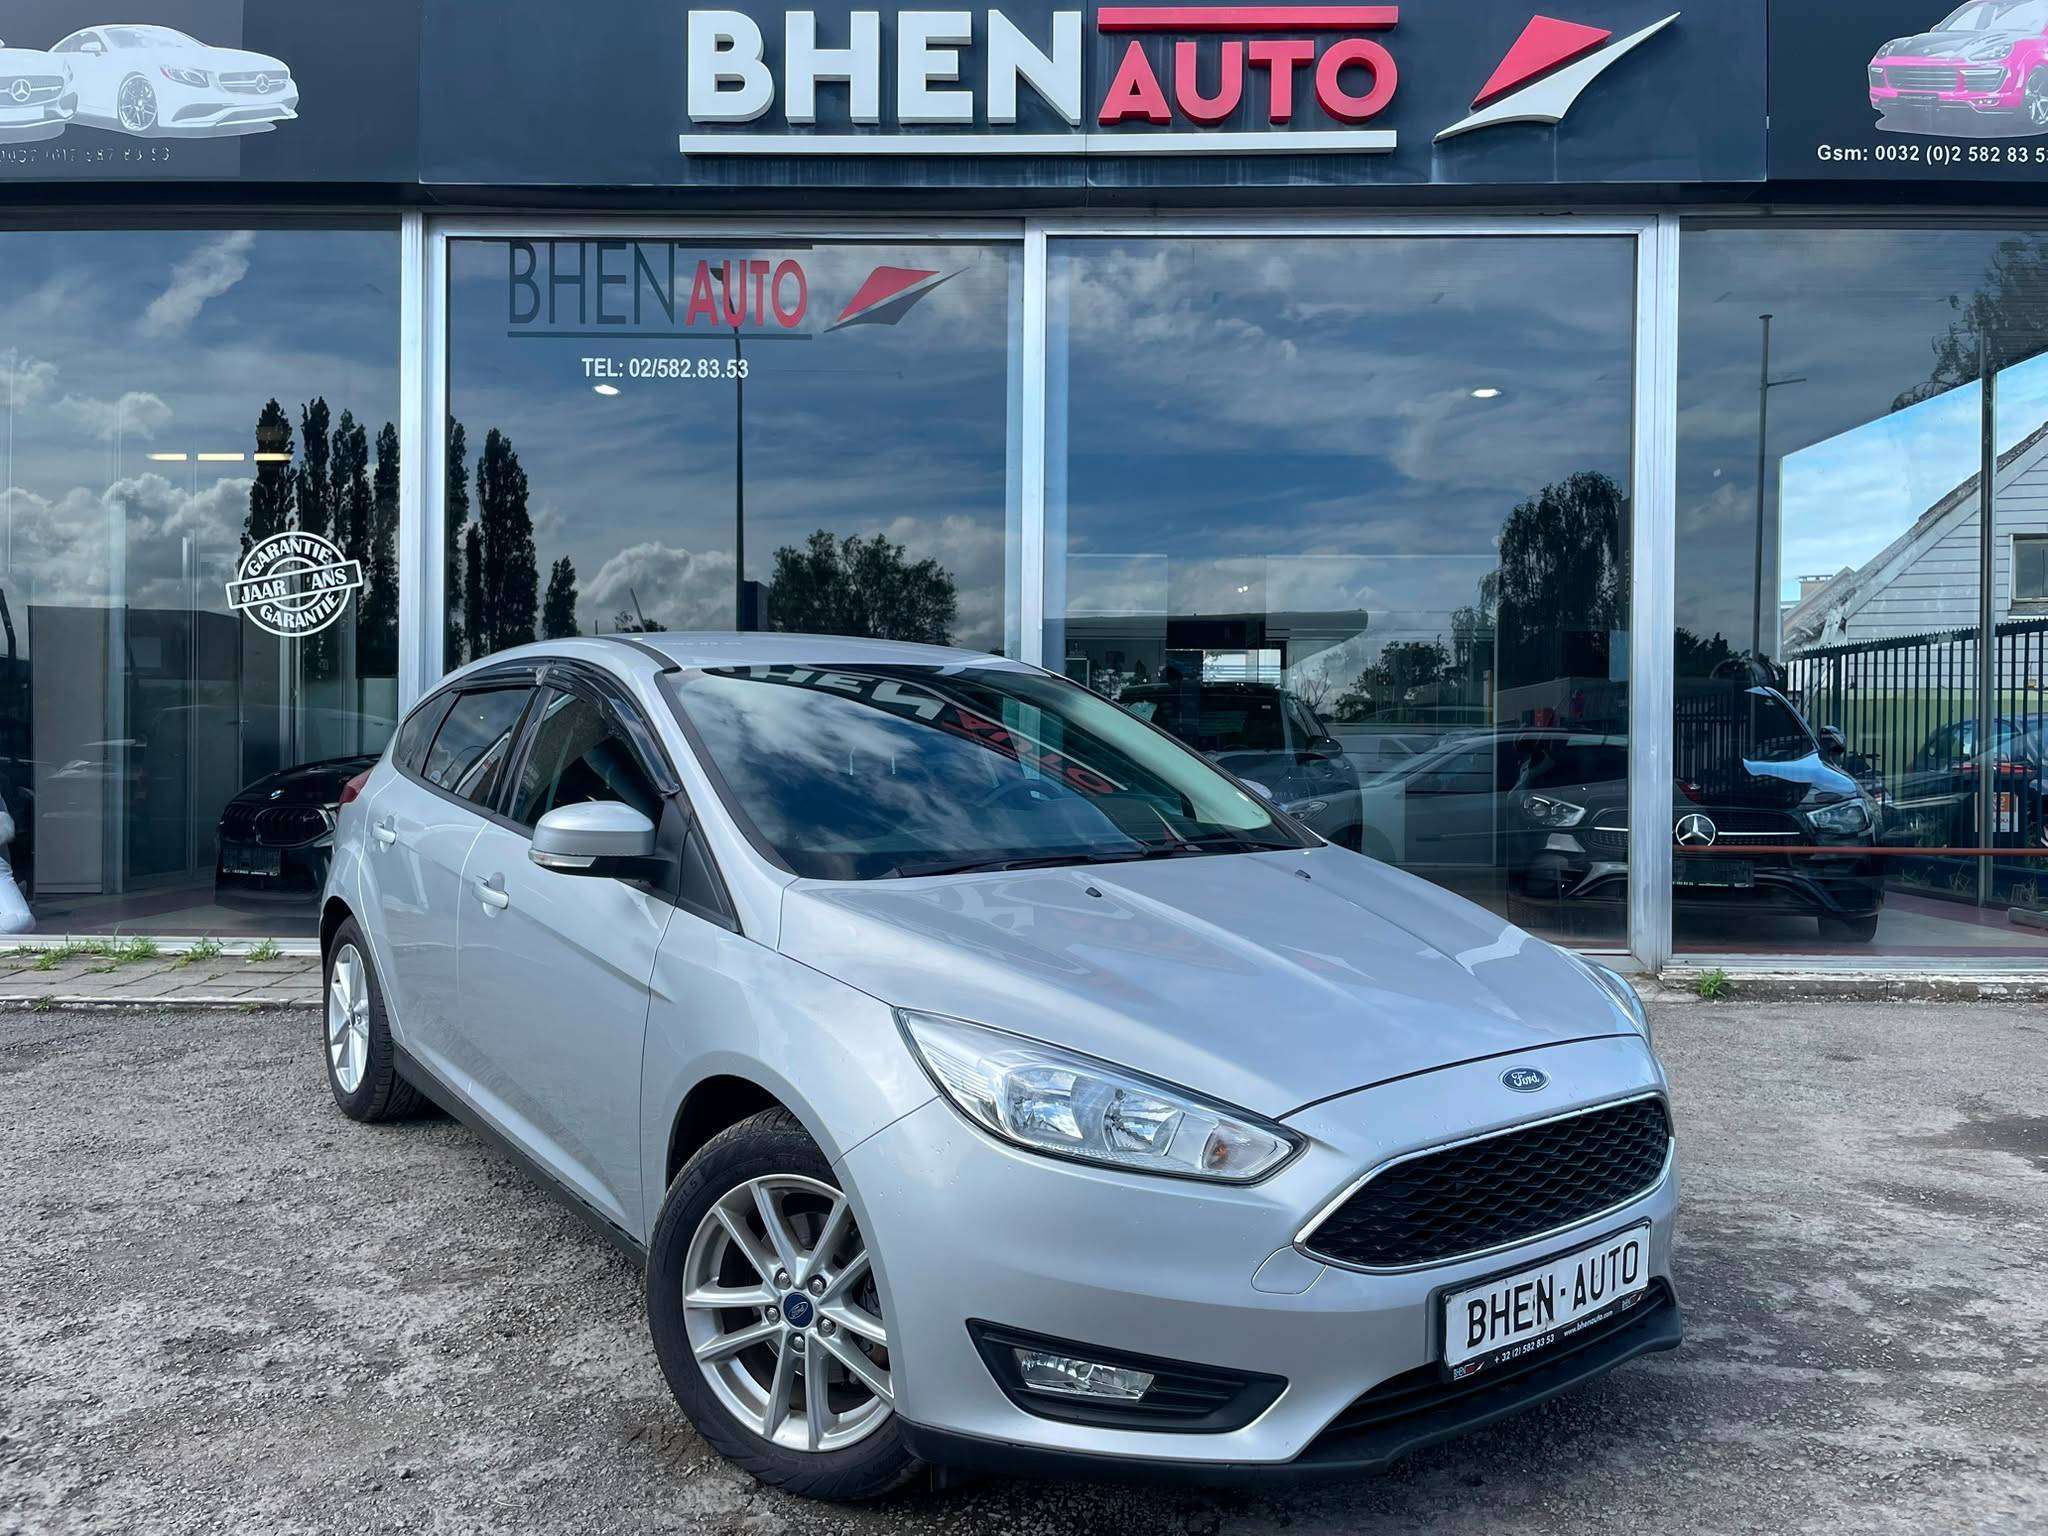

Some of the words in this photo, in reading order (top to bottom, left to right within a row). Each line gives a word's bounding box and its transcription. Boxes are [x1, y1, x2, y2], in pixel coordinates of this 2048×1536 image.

[687, 9, 1082, 126] BHEN
[1097, 38, 1398, 125] AUTO
[1817, 144, 1868, 162] Gsm:
[1875, 144, 1920, 162] 0032
[1926, 144, 1961, 165] (0)2
[1968, 145, 2001, 163] 582
[2007, 146, 2029, 163] 83
[2035, 147, 2048, 163] 5
[508, 240, 675, 325] BHEN
[685, 258, 808, 328] AUTO
[581, 357, 624, 378] TEL:
[628, 357, 749, 379] 02/582.83.53
[247, 538, 333, 577] GARANTIE
[241, 579, 287, 603] JAAR
[311, 568, 348, 590] ANS
[260, 590, 340, 629] GARANTIE
[1510, 1069, 1540, 1087] Ford
[1466, 1273, 1555, 1349] BHEN
[1572, 1240, 1640, 1312] AUTO
